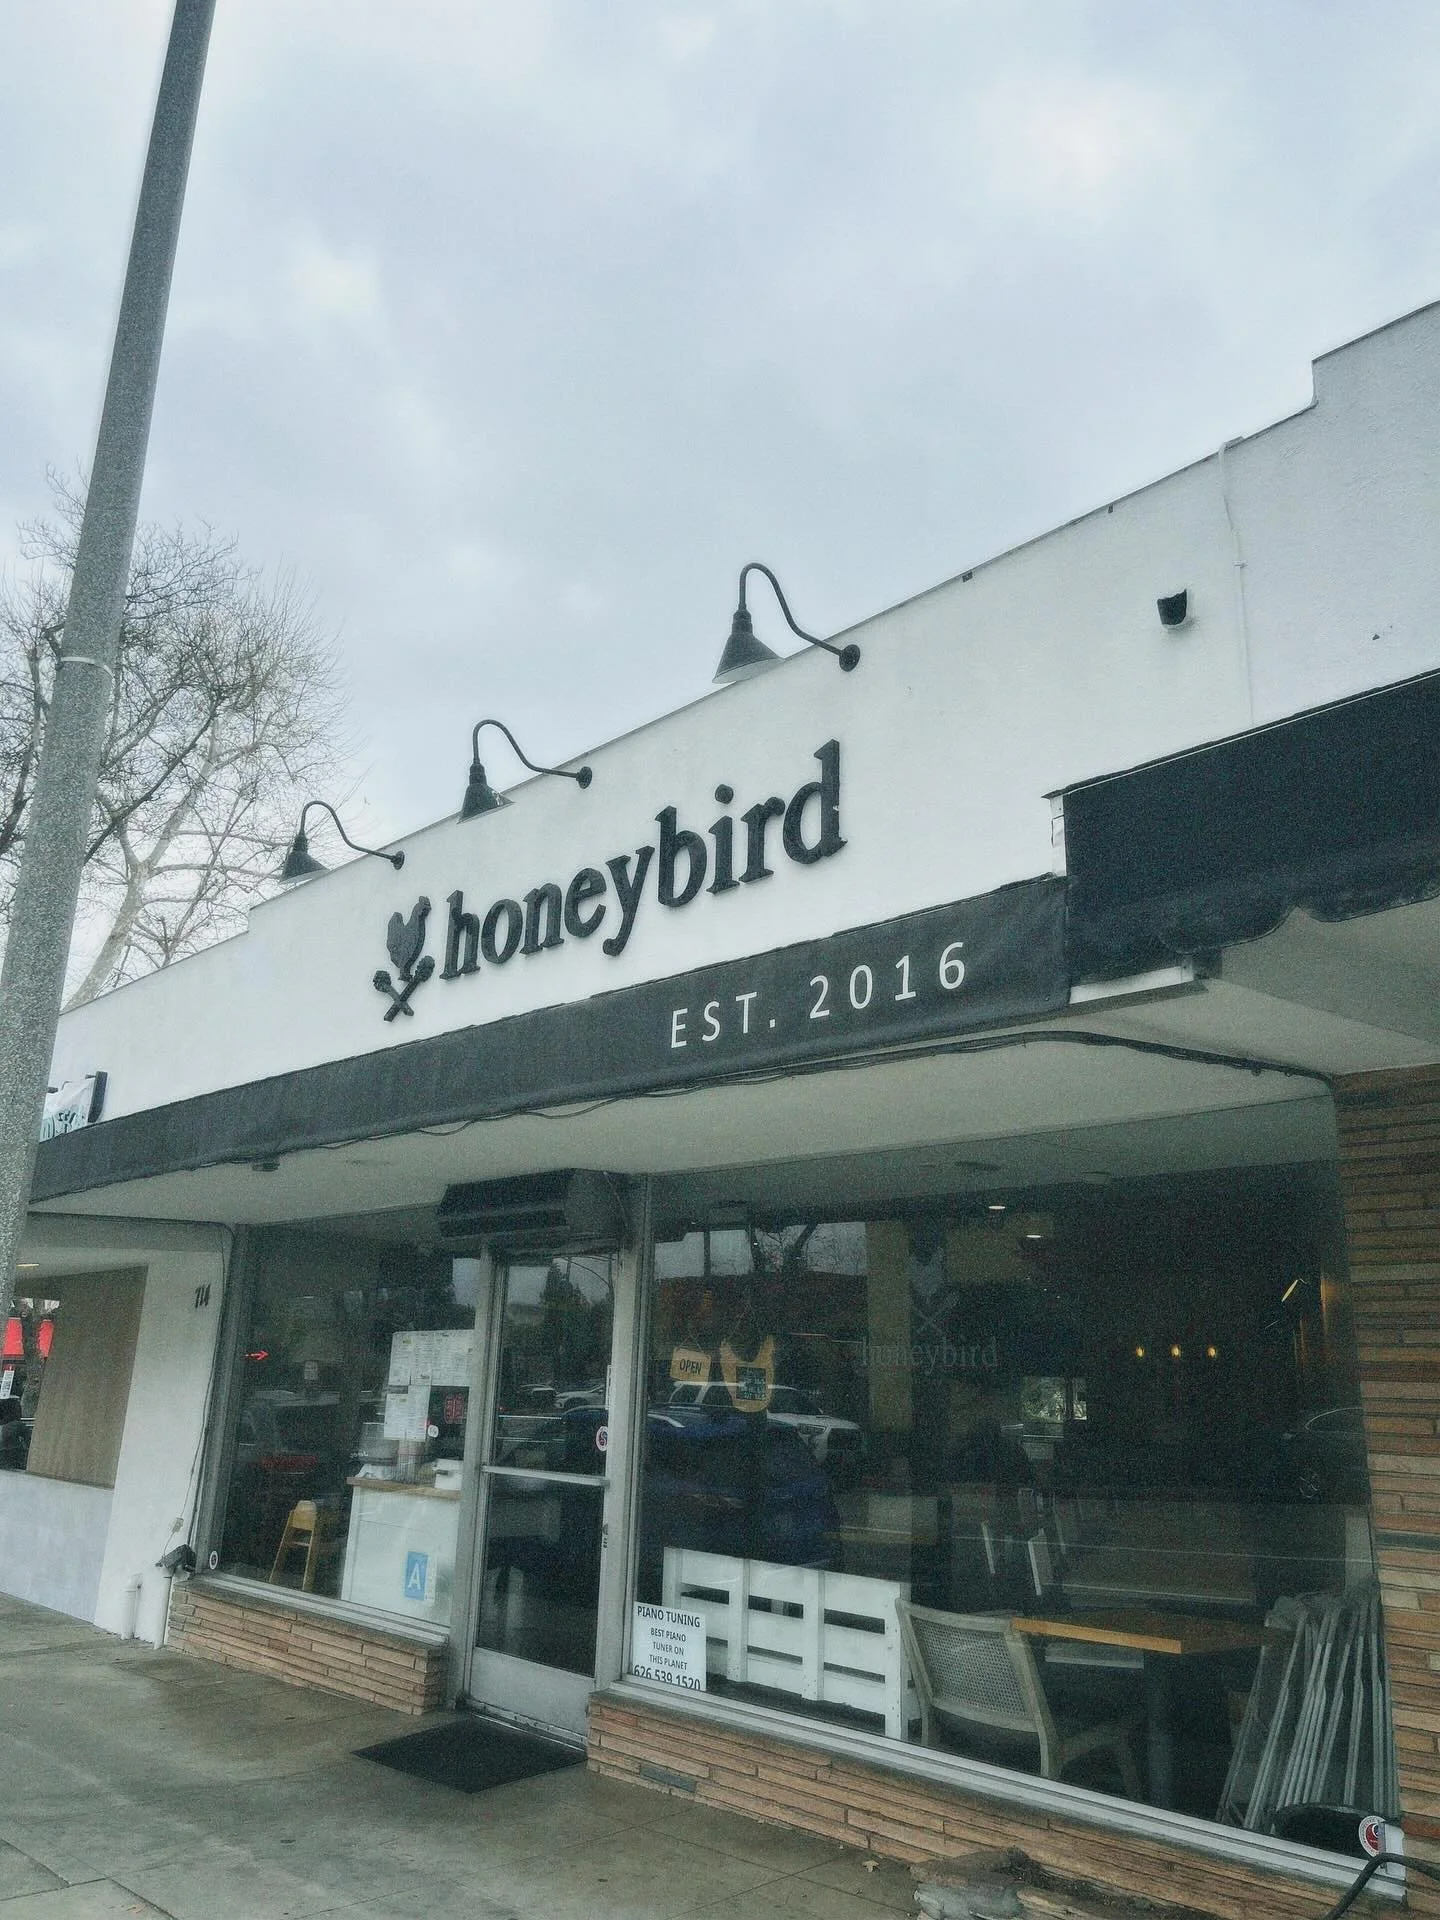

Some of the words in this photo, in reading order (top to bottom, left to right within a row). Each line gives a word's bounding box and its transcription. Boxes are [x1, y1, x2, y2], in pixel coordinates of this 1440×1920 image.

[440, 739, 847, 979] honeybird
[671, 991, 775, 1049] EST.
[810, 942, 965, 1019] 2016
[680, 1358, 702, 1375] OPEN
[407, 1561, 422, 1591] A
[637, 1605, 664, 1621] PIANO
[666, 1611, 701, 1628] TUNING
[650, 1627, 665, 1638] BEST
[666, 1630, 687, 1642] PIANO
[653, 1641, 673, 1653] TUNER
[674, 1646, 685, 1656] ON
[649, 1654, 663, 1665] THIS
[664, 1657, 688, 1670] PLANET
[633, 1664, 652, 1679] 626
[655, 1669, 673, 1684] 539
